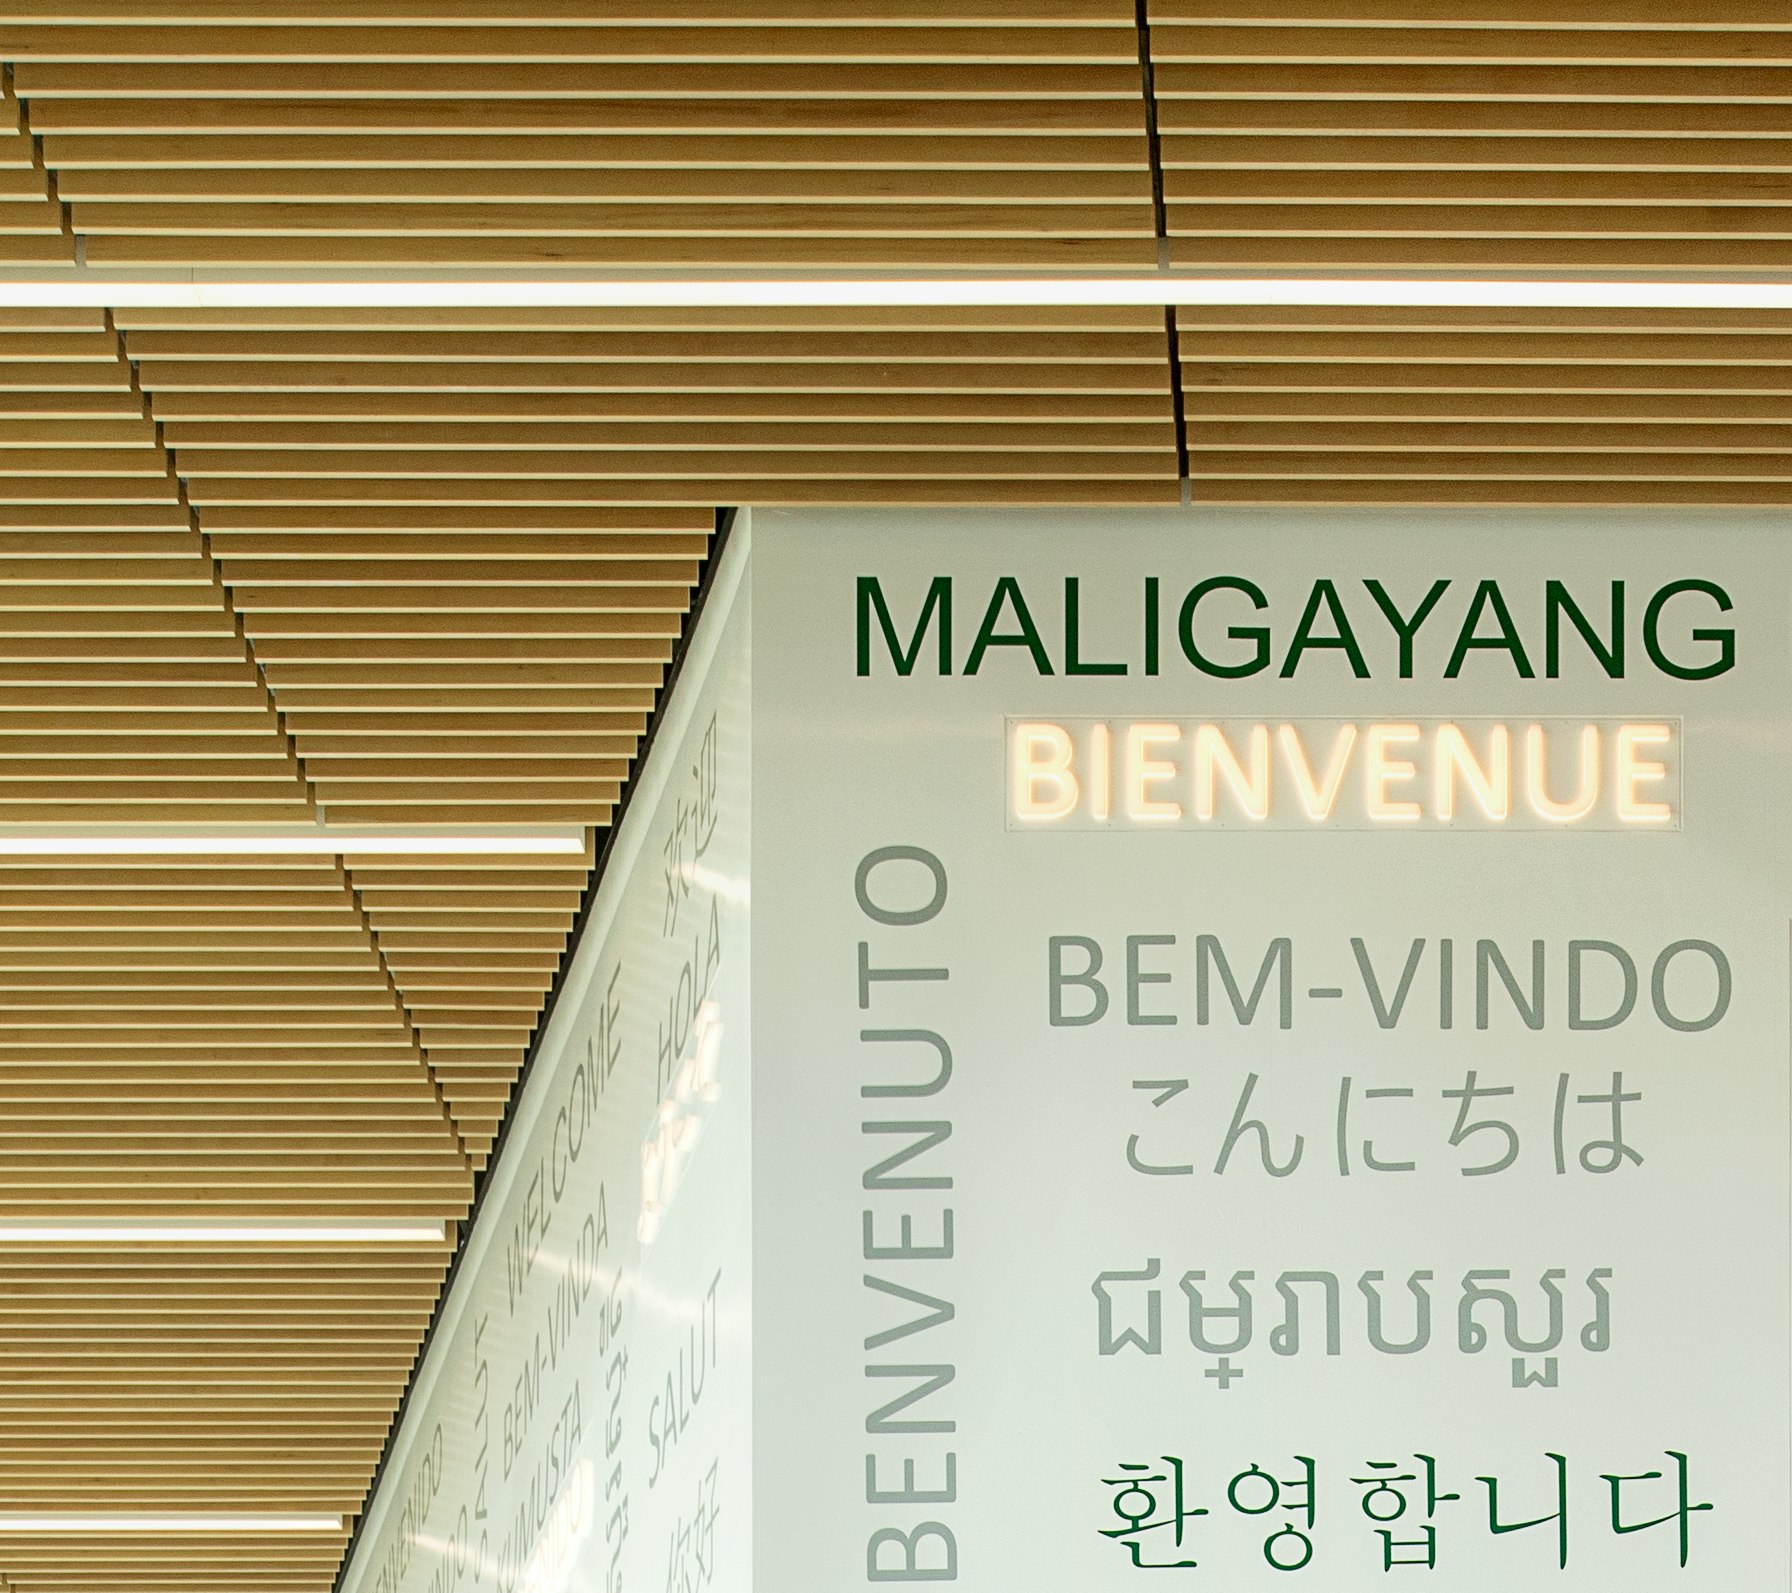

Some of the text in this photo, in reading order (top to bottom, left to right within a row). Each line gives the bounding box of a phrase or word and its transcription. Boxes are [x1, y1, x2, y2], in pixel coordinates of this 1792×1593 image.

[857, 577, 1735, 680] MALIGAYANG
[662, 708, 717, 938] 欢迎
[1012, 722, 1674, 822] BIENVENUE
[656, 891, 720, 1111] HOLA
[1049, 934, 1732, 1032] BEM-VINDO
[507, 959, 621, 1319] WELCOME
[855, 845, 957, 1581] BENVENUTO
[1125, 1071, 1643, 1177] こんにちは
[503, 1180, 608, 1483] BEM-VINDA
[648, 1265, 721, 1490] SALUT
[474, 1312, 488, 1585] SALUT
[1098, 1450, 1713, 1571] 환영합니다
